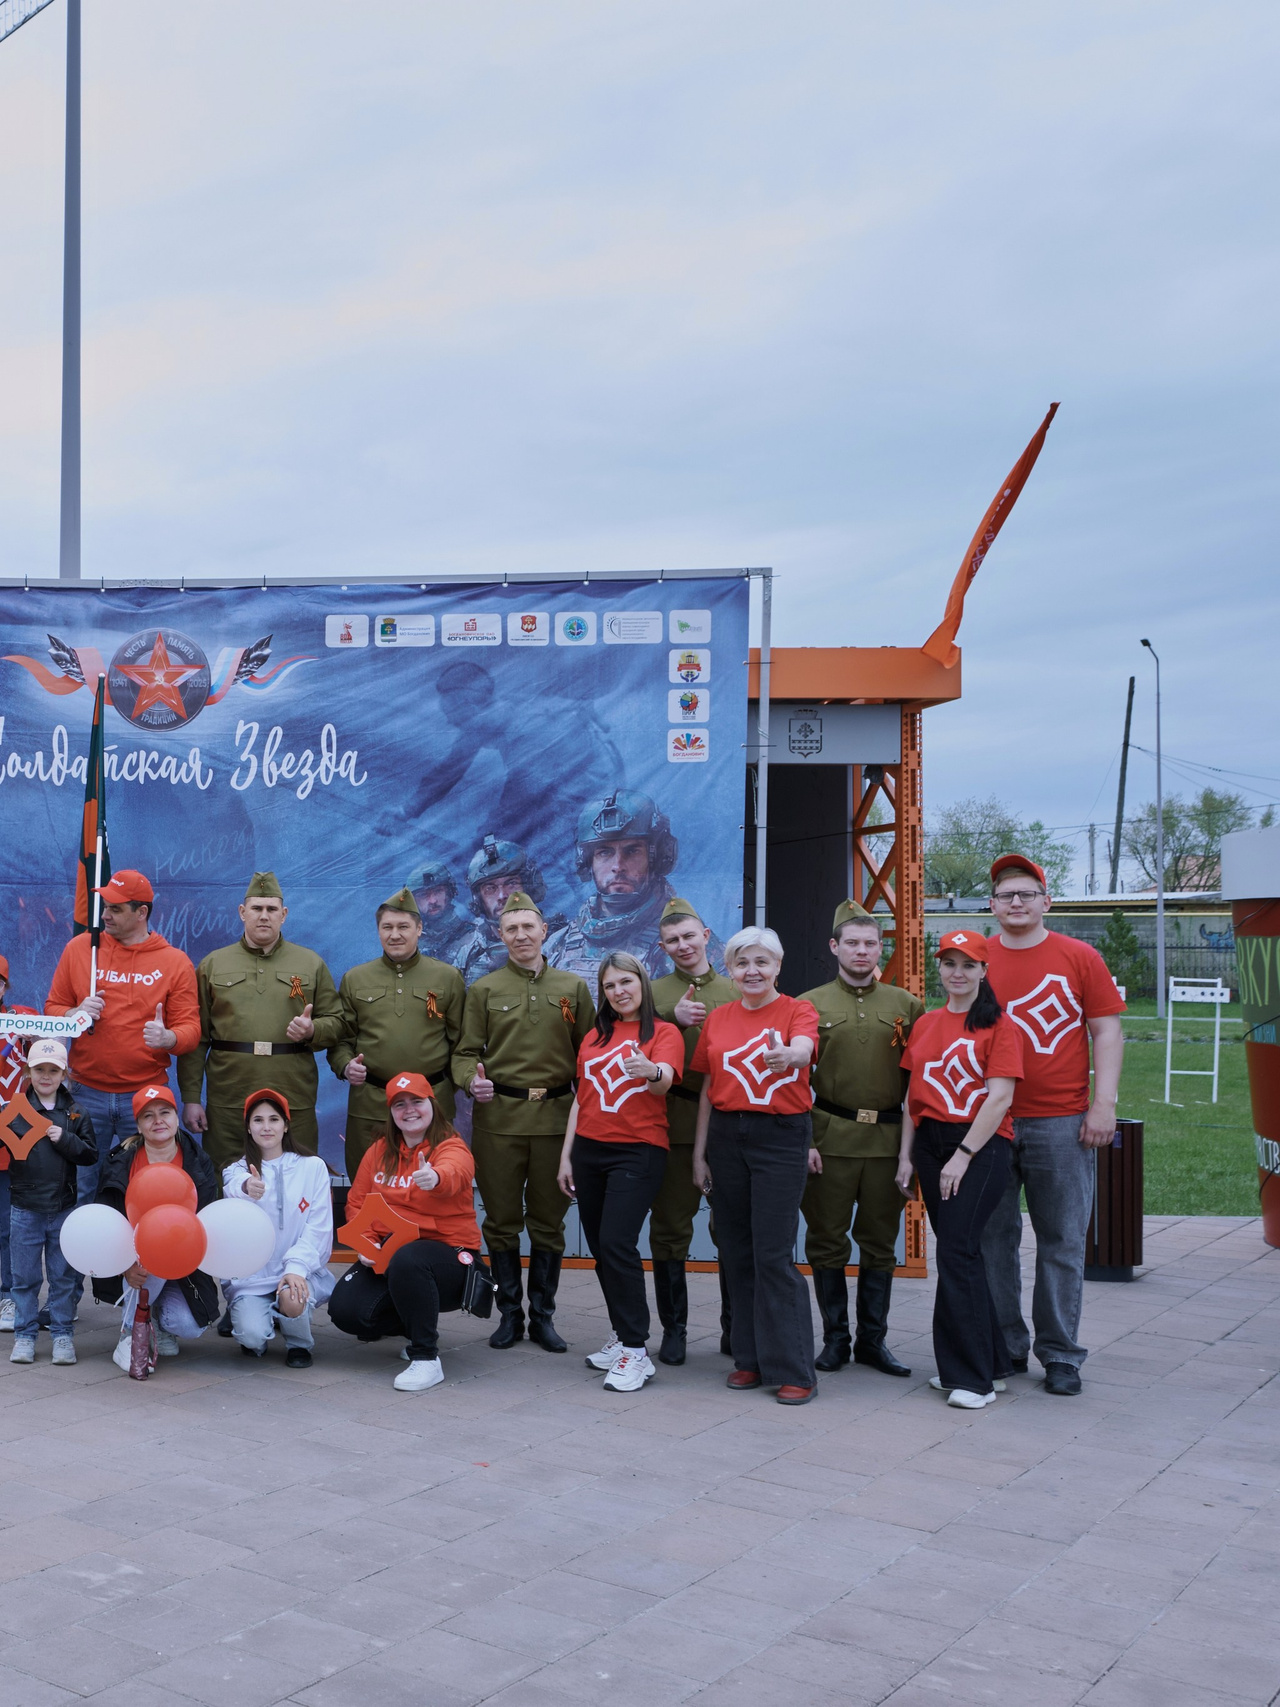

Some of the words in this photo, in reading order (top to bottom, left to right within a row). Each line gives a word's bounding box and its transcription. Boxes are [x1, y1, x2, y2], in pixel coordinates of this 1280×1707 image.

[123, 638, 147, 658] ЧЕСТЬ
[167, 637, 196, 660] ПАМЯТЬ
[112, 679, 128, 687] 1941
[140, 713, 177, 725] ТРАДИЦИИ
[230, 719, 368, 800] Звезда
[1237, 937, 1280, 1007] ВКУ
